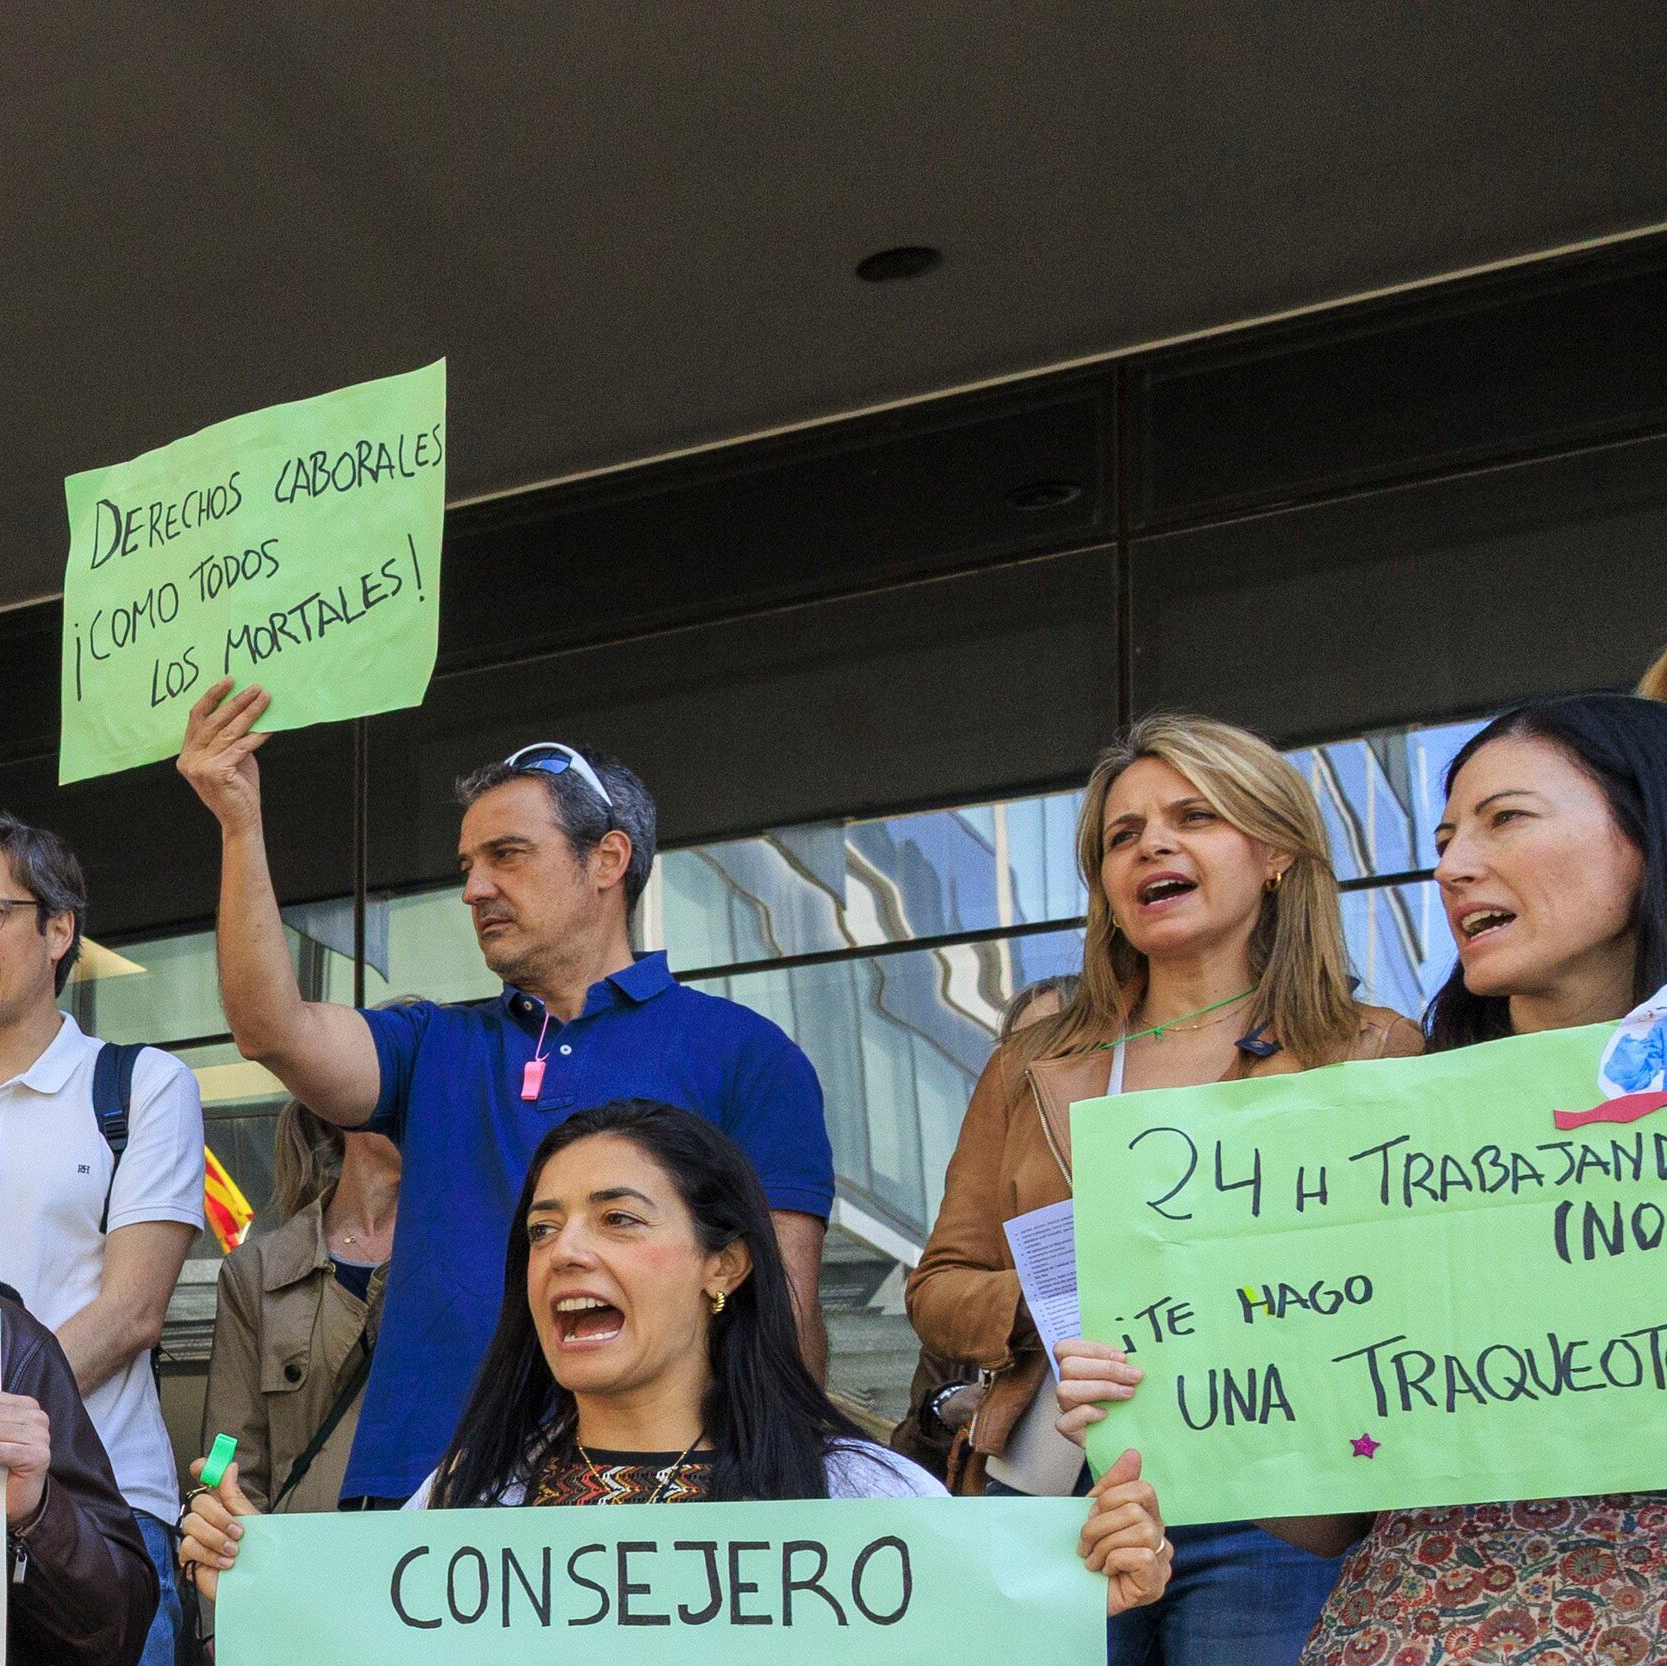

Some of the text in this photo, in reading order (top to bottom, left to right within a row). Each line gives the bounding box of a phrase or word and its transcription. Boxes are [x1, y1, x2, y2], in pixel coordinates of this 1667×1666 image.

[90, 471, 242, 569] DERECHOS
[74, 538, 280, 701] ¡COMO TODOS
[150, 645, 200, 707] LOS
[1128, 1126, 1262, 1219] 24
[1554, 1200, 1665, 1264] (NO
[1116, 1275, 1374, 1355] ¡TE HAGO
[1177, 1362, 1296, 1431] UNA
[389, 1534, 913, 1630] CONSEJERO
